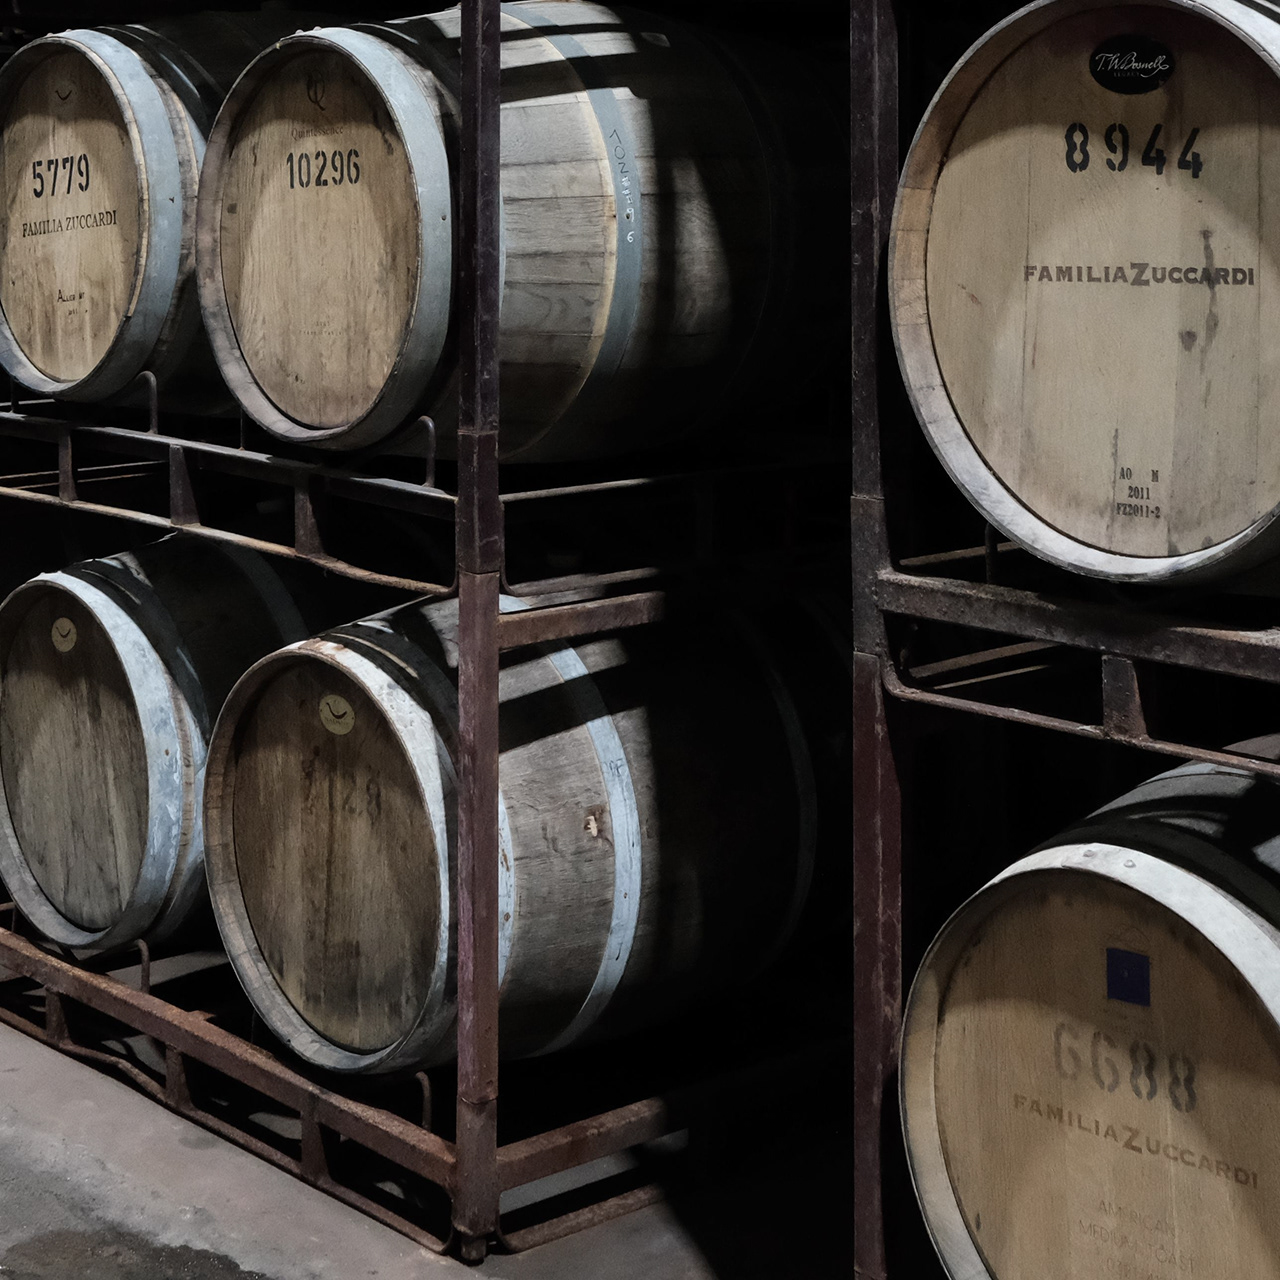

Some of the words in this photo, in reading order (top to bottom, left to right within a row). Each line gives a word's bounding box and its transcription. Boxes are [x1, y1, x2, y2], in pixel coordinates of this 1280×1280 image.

[290, 125, 344, 141] Quintessence
[1064, 122, 1204, 179] 8944
[32, 153, 90, 199] 5779
[286, 148, 360, 189] 10296
[22, 218, 64, 238] FAMILIA
[65, 210, 117, 232] ZUCCARDI
[1023, 261, 1255, 288] FAMILIAZUCCARDI
[1128, 485, 1150, 500] 2011
[1116, 503, 1161, 519] FZ2011-2
[1052, 1020, 1197, 1114] 6688
[1013, 1093, 1261, 1189] FAMILIAZUCCARDI
